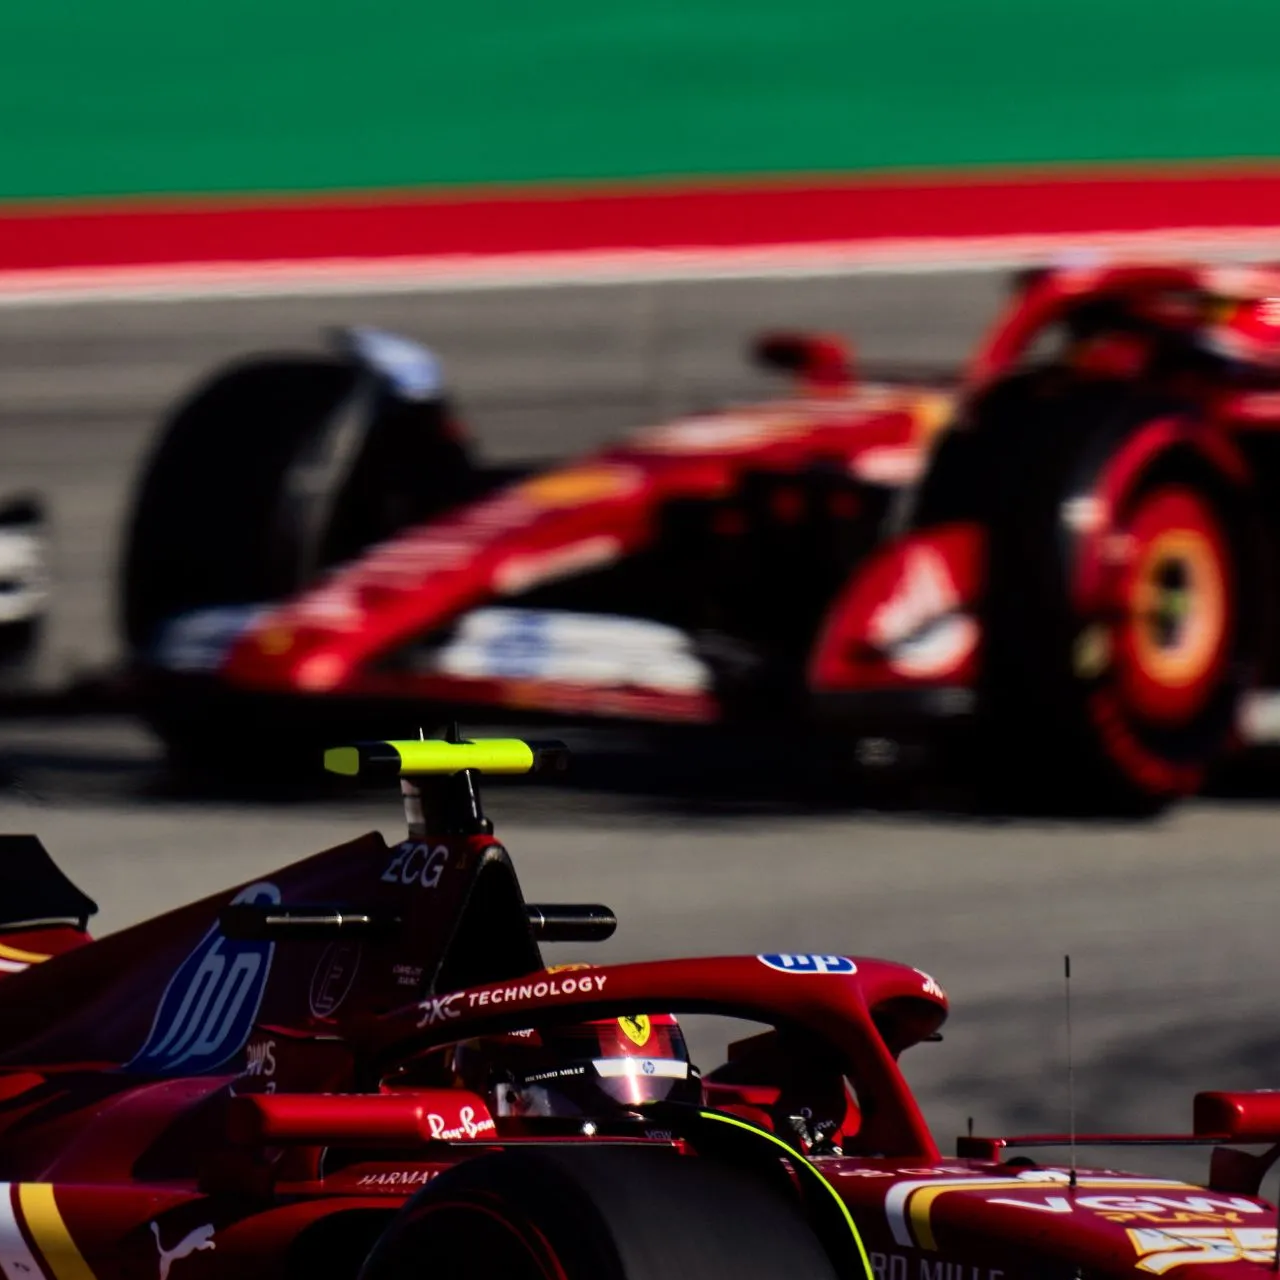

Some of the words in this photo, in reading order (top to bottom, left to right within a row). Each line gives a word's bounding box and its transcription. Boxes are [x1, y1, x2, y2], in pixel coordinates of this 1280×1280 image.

[379, 842, 449, 889] ZCG
[468, 975, 608, 1008] TECHNOLOGY
[426, 1105, 496, 1140] Ray-Ban
[985, 1195, 1265, 1213] VGW
